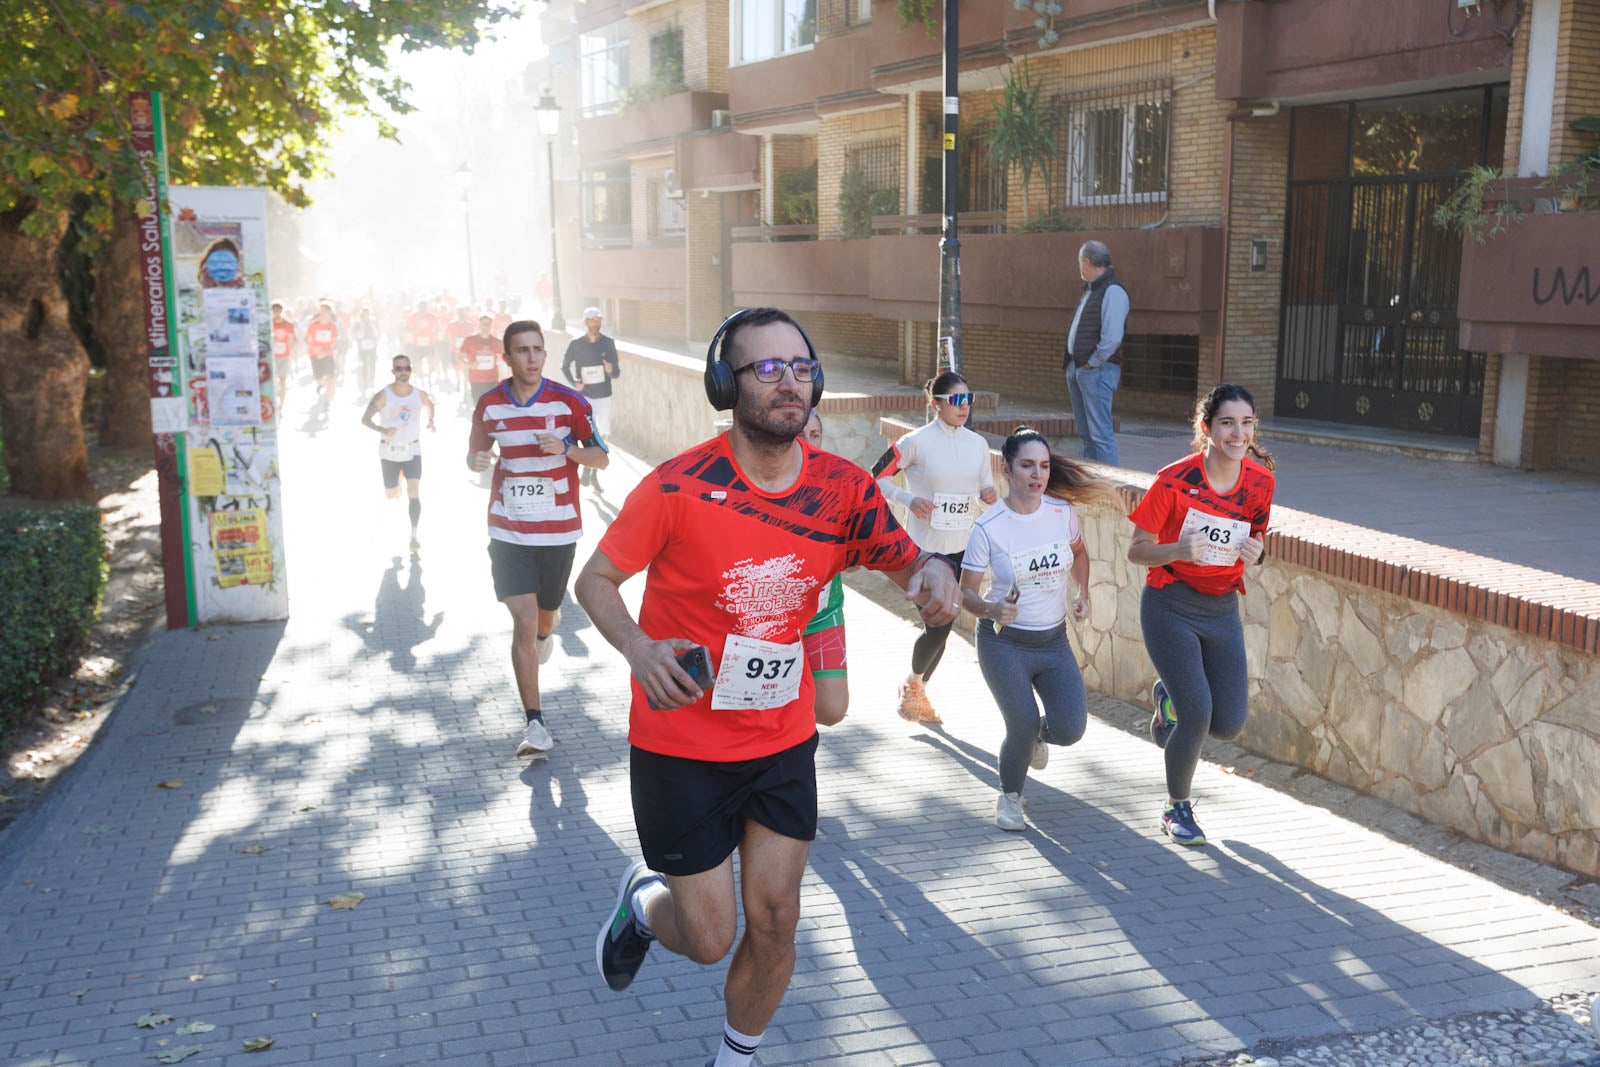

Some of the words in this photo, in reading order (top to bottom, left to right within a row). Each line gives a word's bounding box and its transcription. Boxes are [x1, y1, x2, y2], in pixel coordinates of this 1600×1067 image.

[510, 484, 544, 497] 1792
[941, 501, 970, 514] 1625
[1028, 552, 1060, 573] 442
[725, 580, 808, 600] carrera
[726, 597, 801, 615] cruzroja.es
[745, 657, 796, 680] 937
